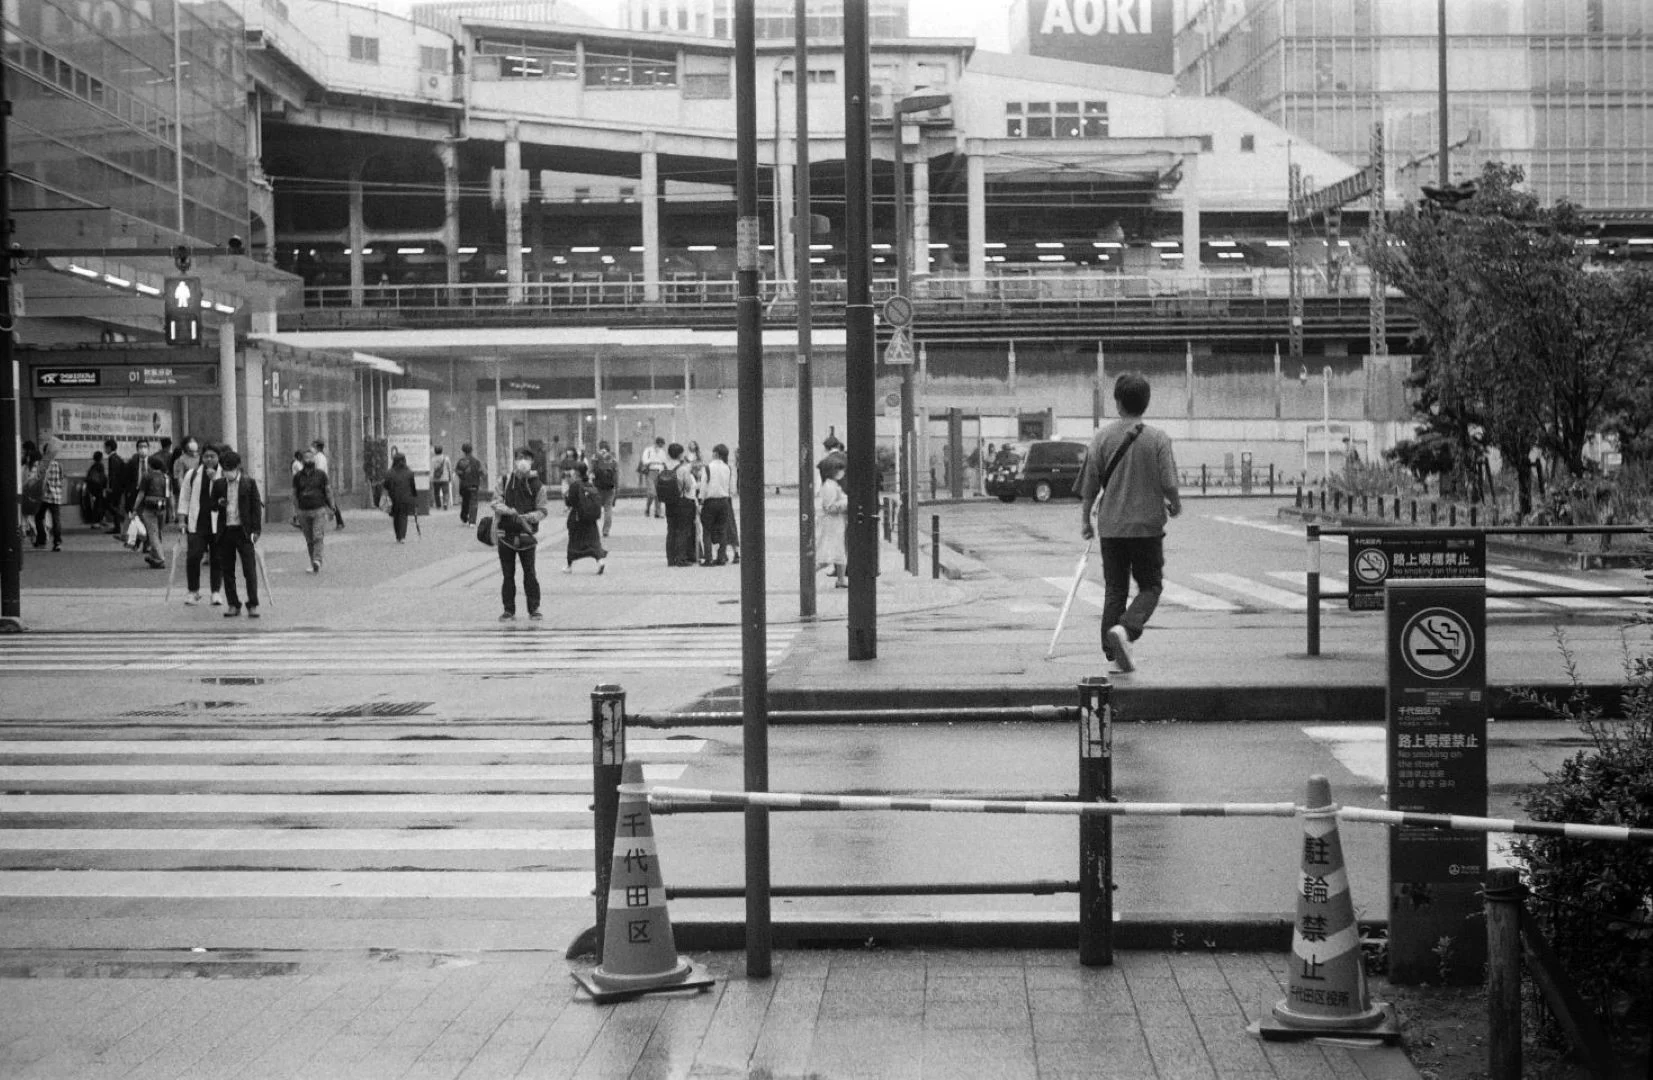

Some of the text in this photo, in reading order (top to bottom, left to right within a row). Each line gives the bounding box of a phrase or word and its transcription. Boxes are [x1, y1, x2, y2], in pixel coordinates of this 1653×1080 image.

[1040, 0, 1153, 36] AOKI
[1393, 552, 1470, 566] 路上喫煙禁止
[1393, 567, 1402, 575] No
[1404, 567, 1433, 577] smoking
[1435, 567, 1445, 575] on
[1446, 567, 1458, 575] the
[1459, 567, 1480, 575] street
[1398, 733, 1479, 748] 路上喫煙禁止
[1398, 750, 1463, 760] No smoking on
[1398, 760, 1439, 768] the street
[622, 812, 651, 944] 千代田区
[1301, 837, 1330, 981] 駐輪禁止
